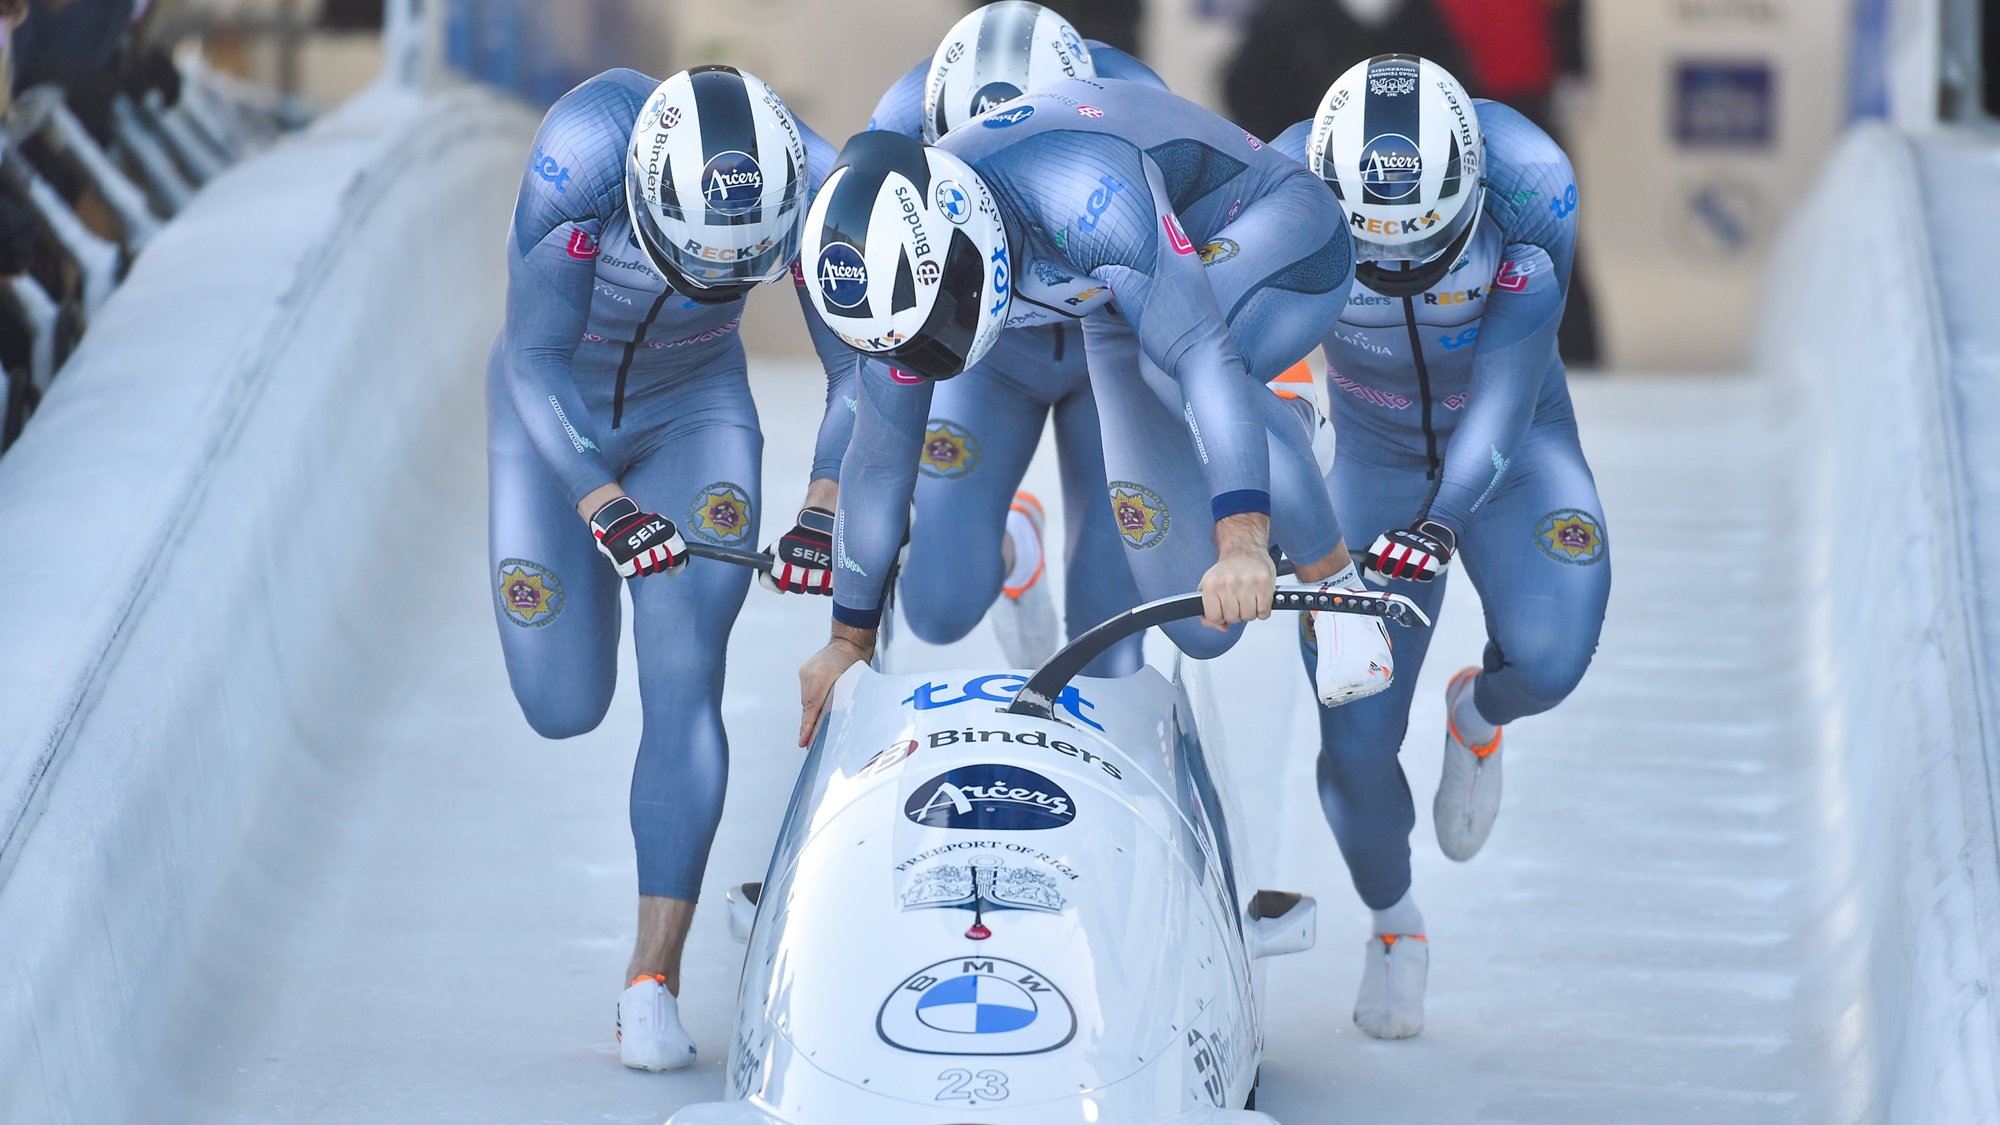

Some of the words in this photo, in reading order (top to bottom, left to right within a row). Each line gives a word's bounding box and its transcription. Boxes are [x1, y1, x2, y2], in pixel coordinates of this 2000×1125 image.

[1051, 41, 1076, 79] ders
[928, 66, 949, 123] Binder
[1437, 81, 1473, 147] Binders
[763, 96, 802, 161] Binders
[1313, 114, 1335, 176] Binder
[647, 132, 668, 204] Binders
[1078, 175, 1128, 233] tet
[1549, 184, 1578, 220] te
[895, 185, 931, 260] Binders
[601, 253, 661, 281] Binders
[594, 283, 632, 306] TVIJA
[1334, 330, 1393, 356] LATVIJA
[1438, 328, 1479, 350] te
[627, 520, 666, 550] SEIZ
[791, 547, 831, 567] SEIZ
[927, 727, 1122, 780] Binders
[908, 779, 1073, 823] Arčers
[895, 841, 1001, 873] FREEPORT
[1005, 843, 1035, 855] OF
[1036, 852, 1081, 882] RIGA
[905, 961, 1052, 992] BMW
[935, 1067, 1010, 1102] 23
